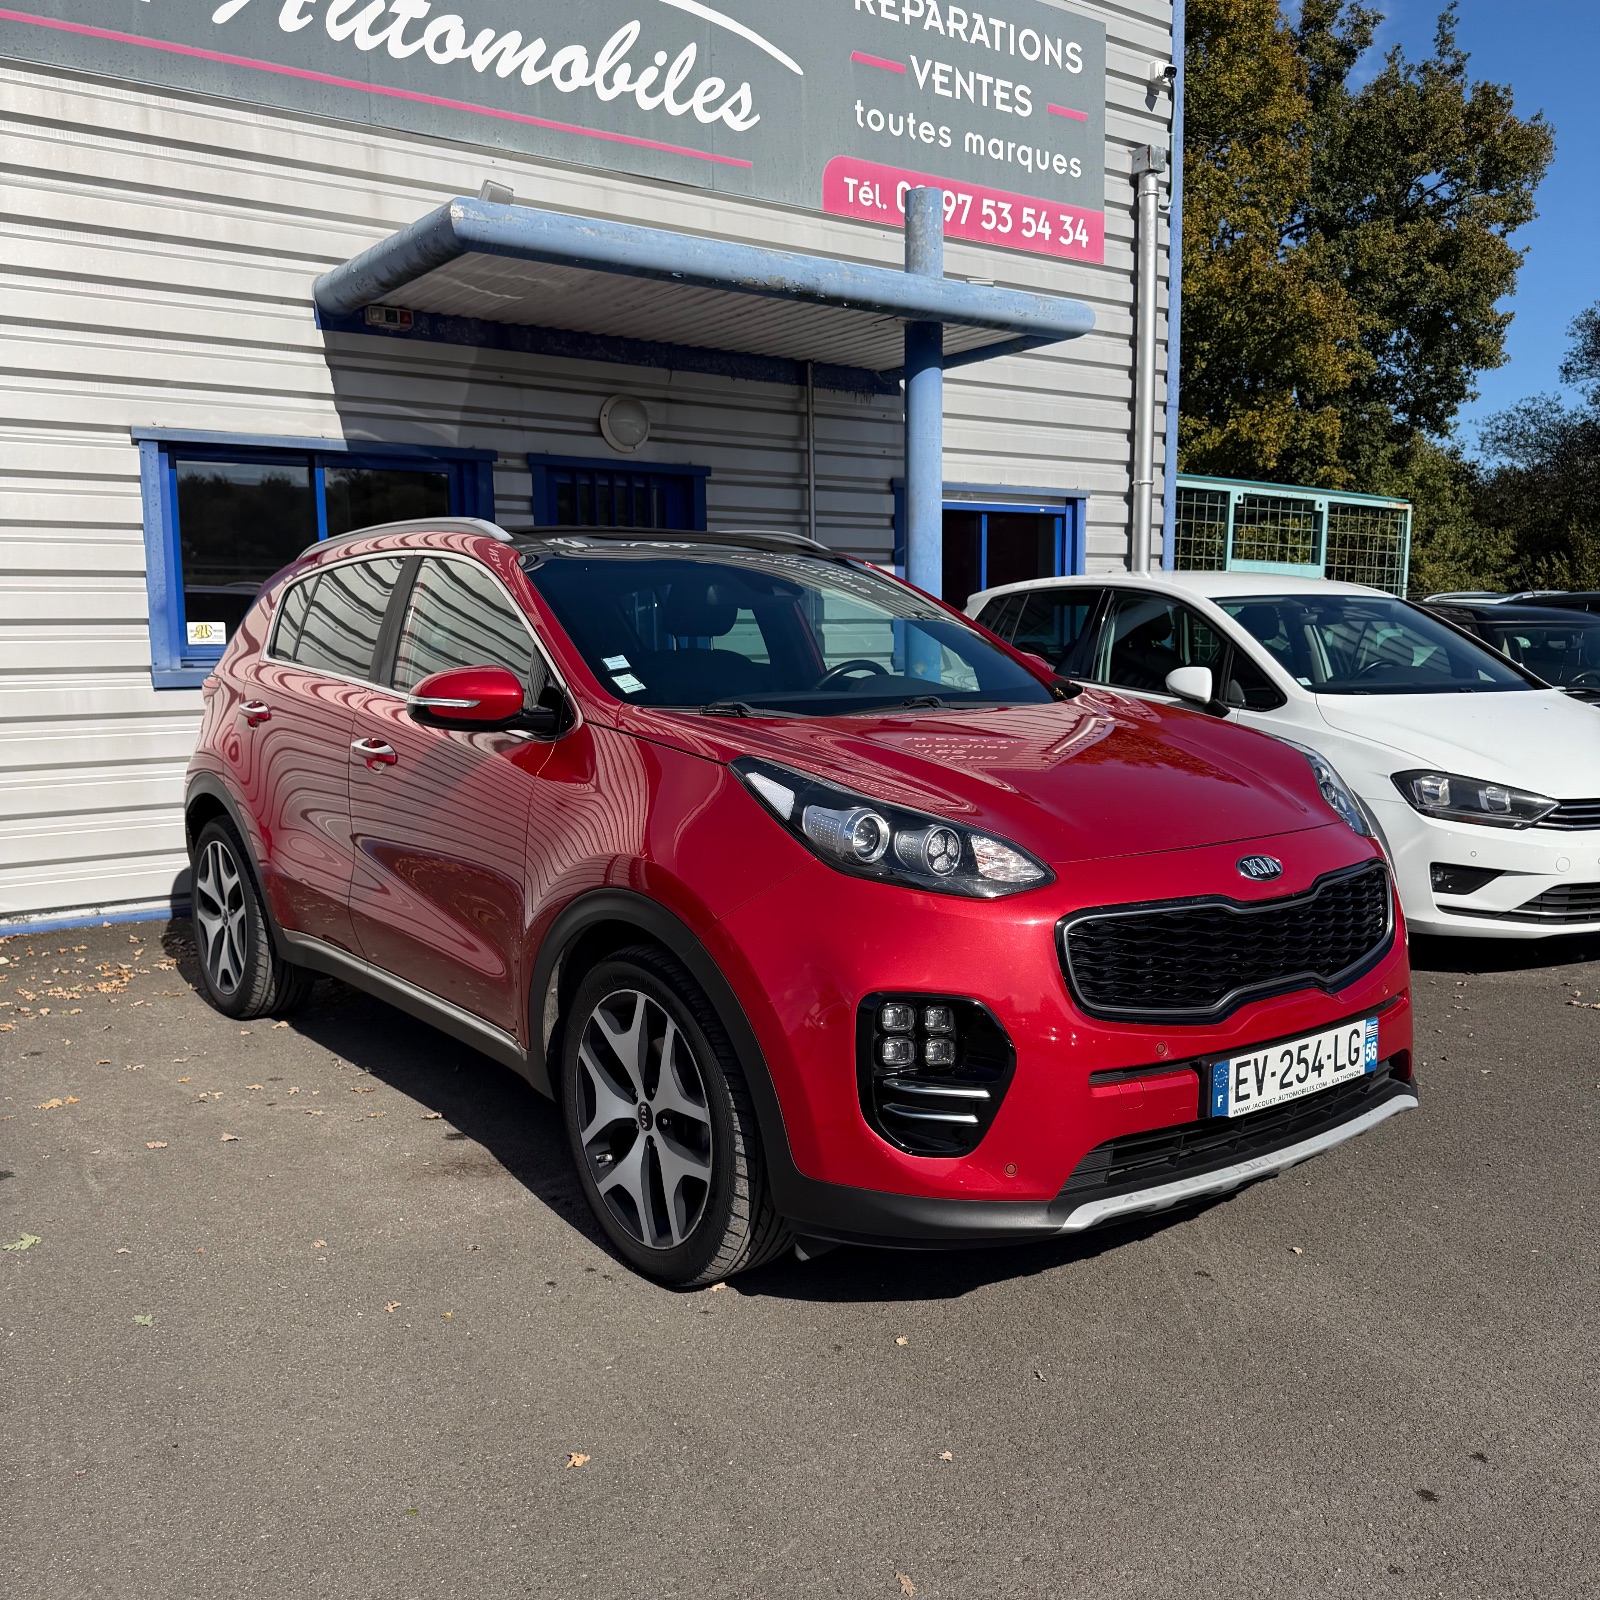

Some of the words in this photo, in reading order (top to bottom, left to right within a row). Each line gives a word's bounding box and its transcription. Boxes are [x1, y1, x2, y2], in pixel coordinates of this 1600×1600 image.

[909, 54, 1034, 118] VENTES
[854, 99, 952, 148] toutes
[964, 131, 1083, 178] marques
[843, 176, 888, 210] Tél.
[941, 189, 974, 225] 97
[980, 198, 1014, 234] 53
[1021, 208, 1052, 241] 54
[1058, 214, 1090, 249] 34
[1242, 857, 1281, 876] KIA
[1234, 1028, 1361, 1104] EV-254-LG
[1365, 1041, 1378, 1062] 56
[640, 1105, 648, 1128] KIA
[1217, 1095, 1224, 1107] F
